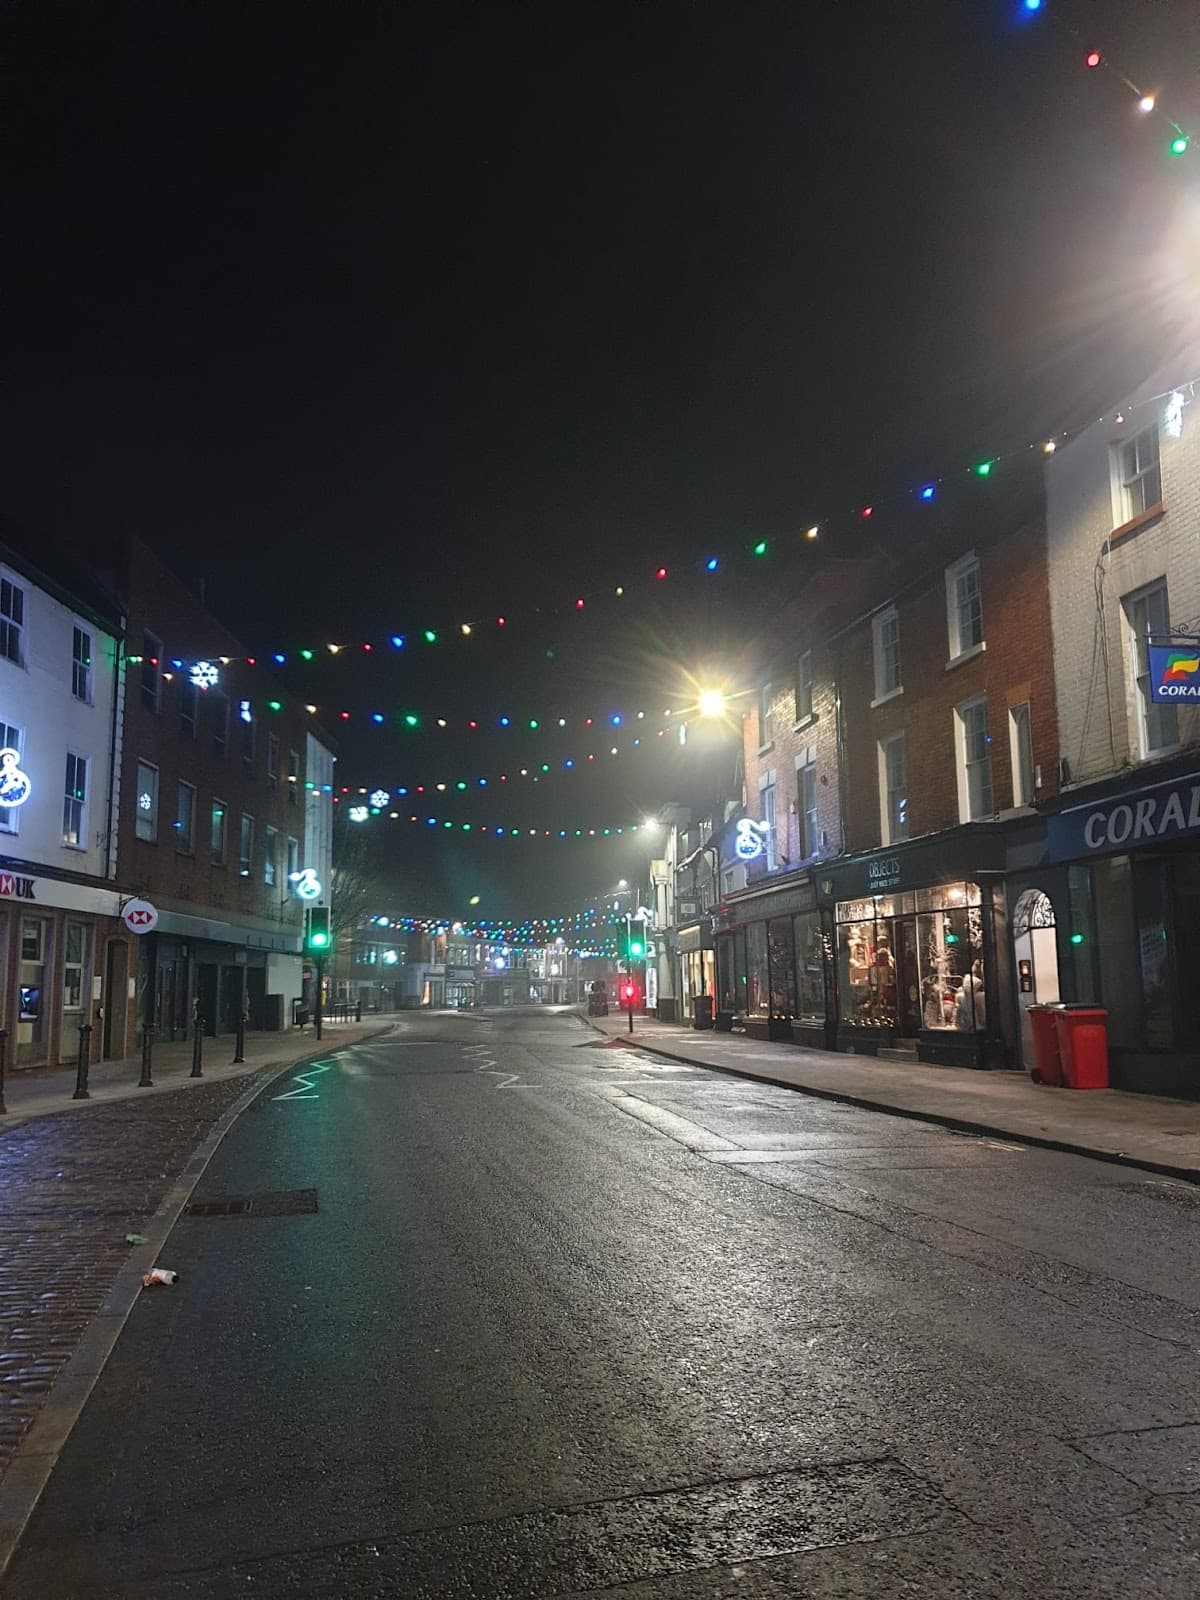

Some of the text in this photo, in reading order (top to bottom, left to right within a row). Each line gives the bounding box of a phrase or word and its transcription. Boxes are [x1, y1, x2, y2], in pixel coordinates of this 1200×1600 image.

[1084, 786, 1200, 848] CORAL
[869, 858, 900, 877] OBJECTS
[15, 877, 35, 899] UK
